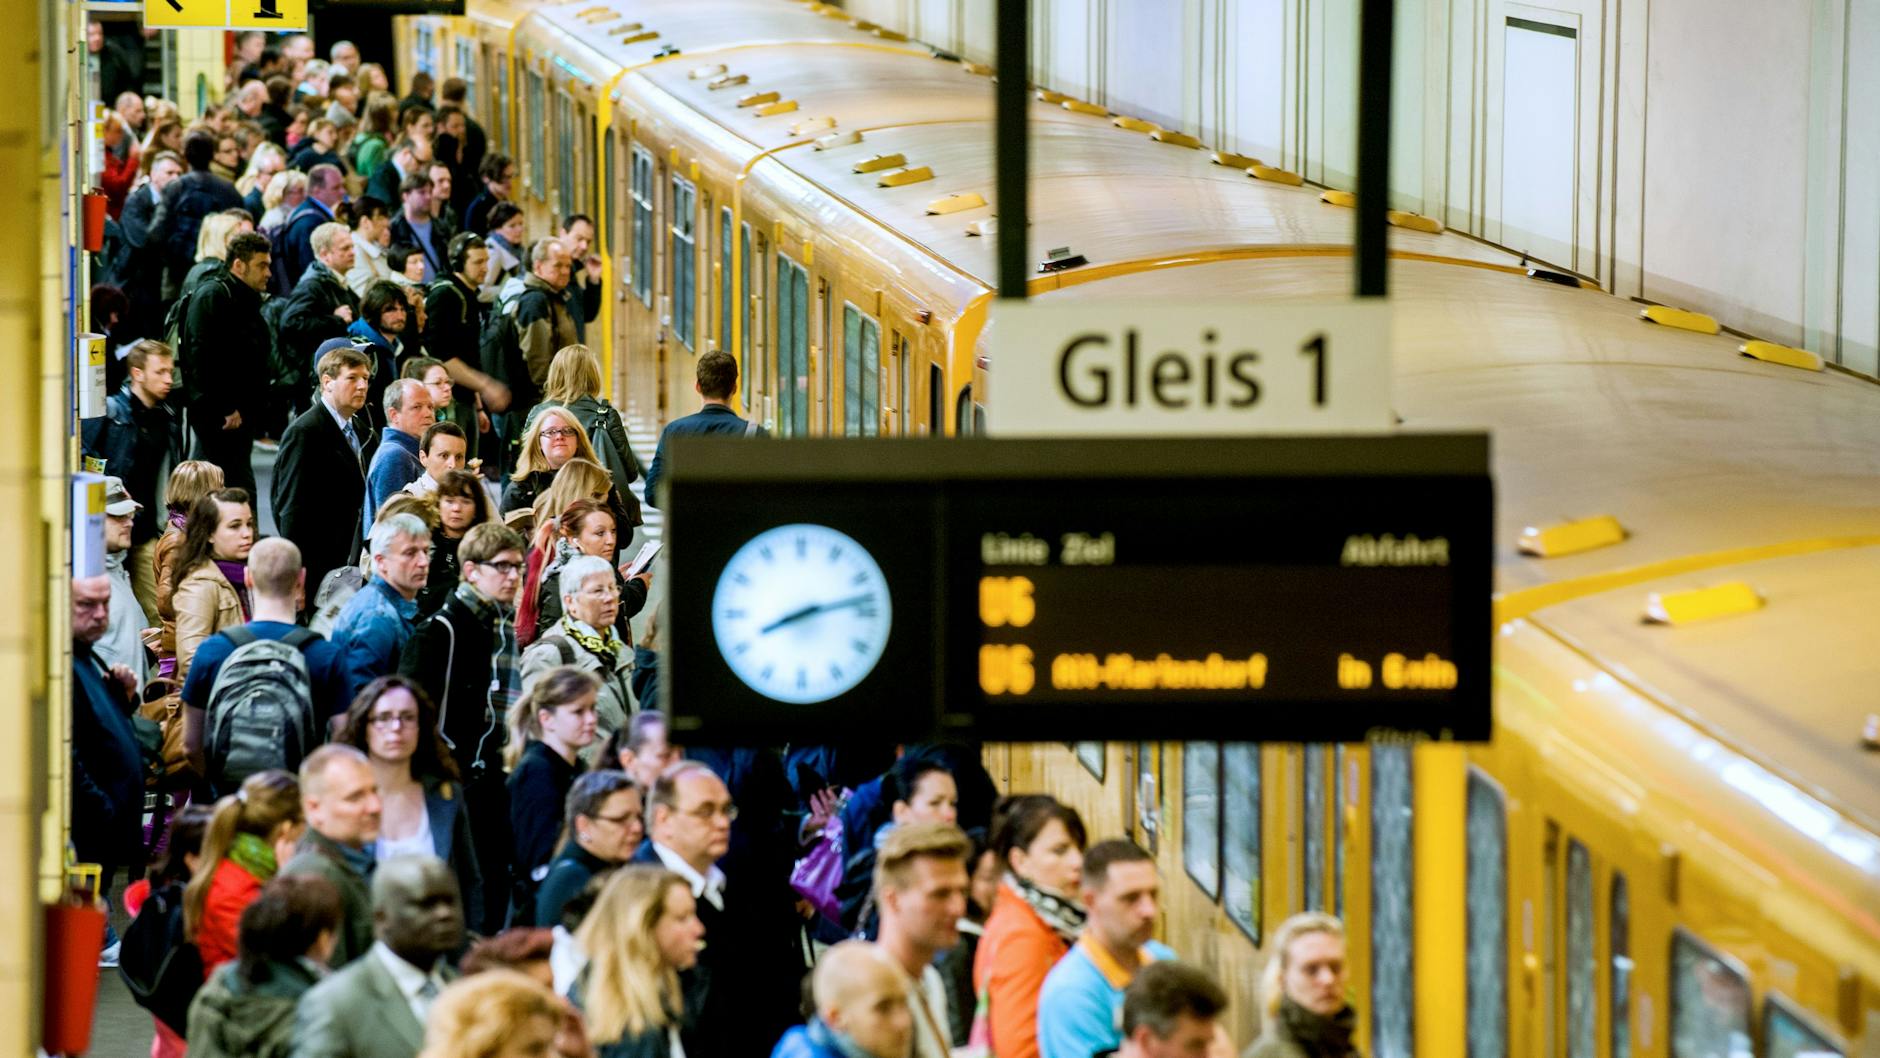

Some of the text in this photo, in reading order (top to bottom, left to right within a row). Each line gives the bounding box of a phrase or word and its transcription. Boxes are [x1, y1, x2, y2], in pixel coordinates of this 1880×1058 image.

[1057, 330, 1329, 408] Gleis 1
[982, 533, 1448, 566] Linie Ziel Abfahrt
[979, 575, 1036, 628] U6
[979, 642, 1036, 696] U6
[1051, 652, 1268, 690] Alt-Mariendorf
[1337, 652, 1373, 689] in
